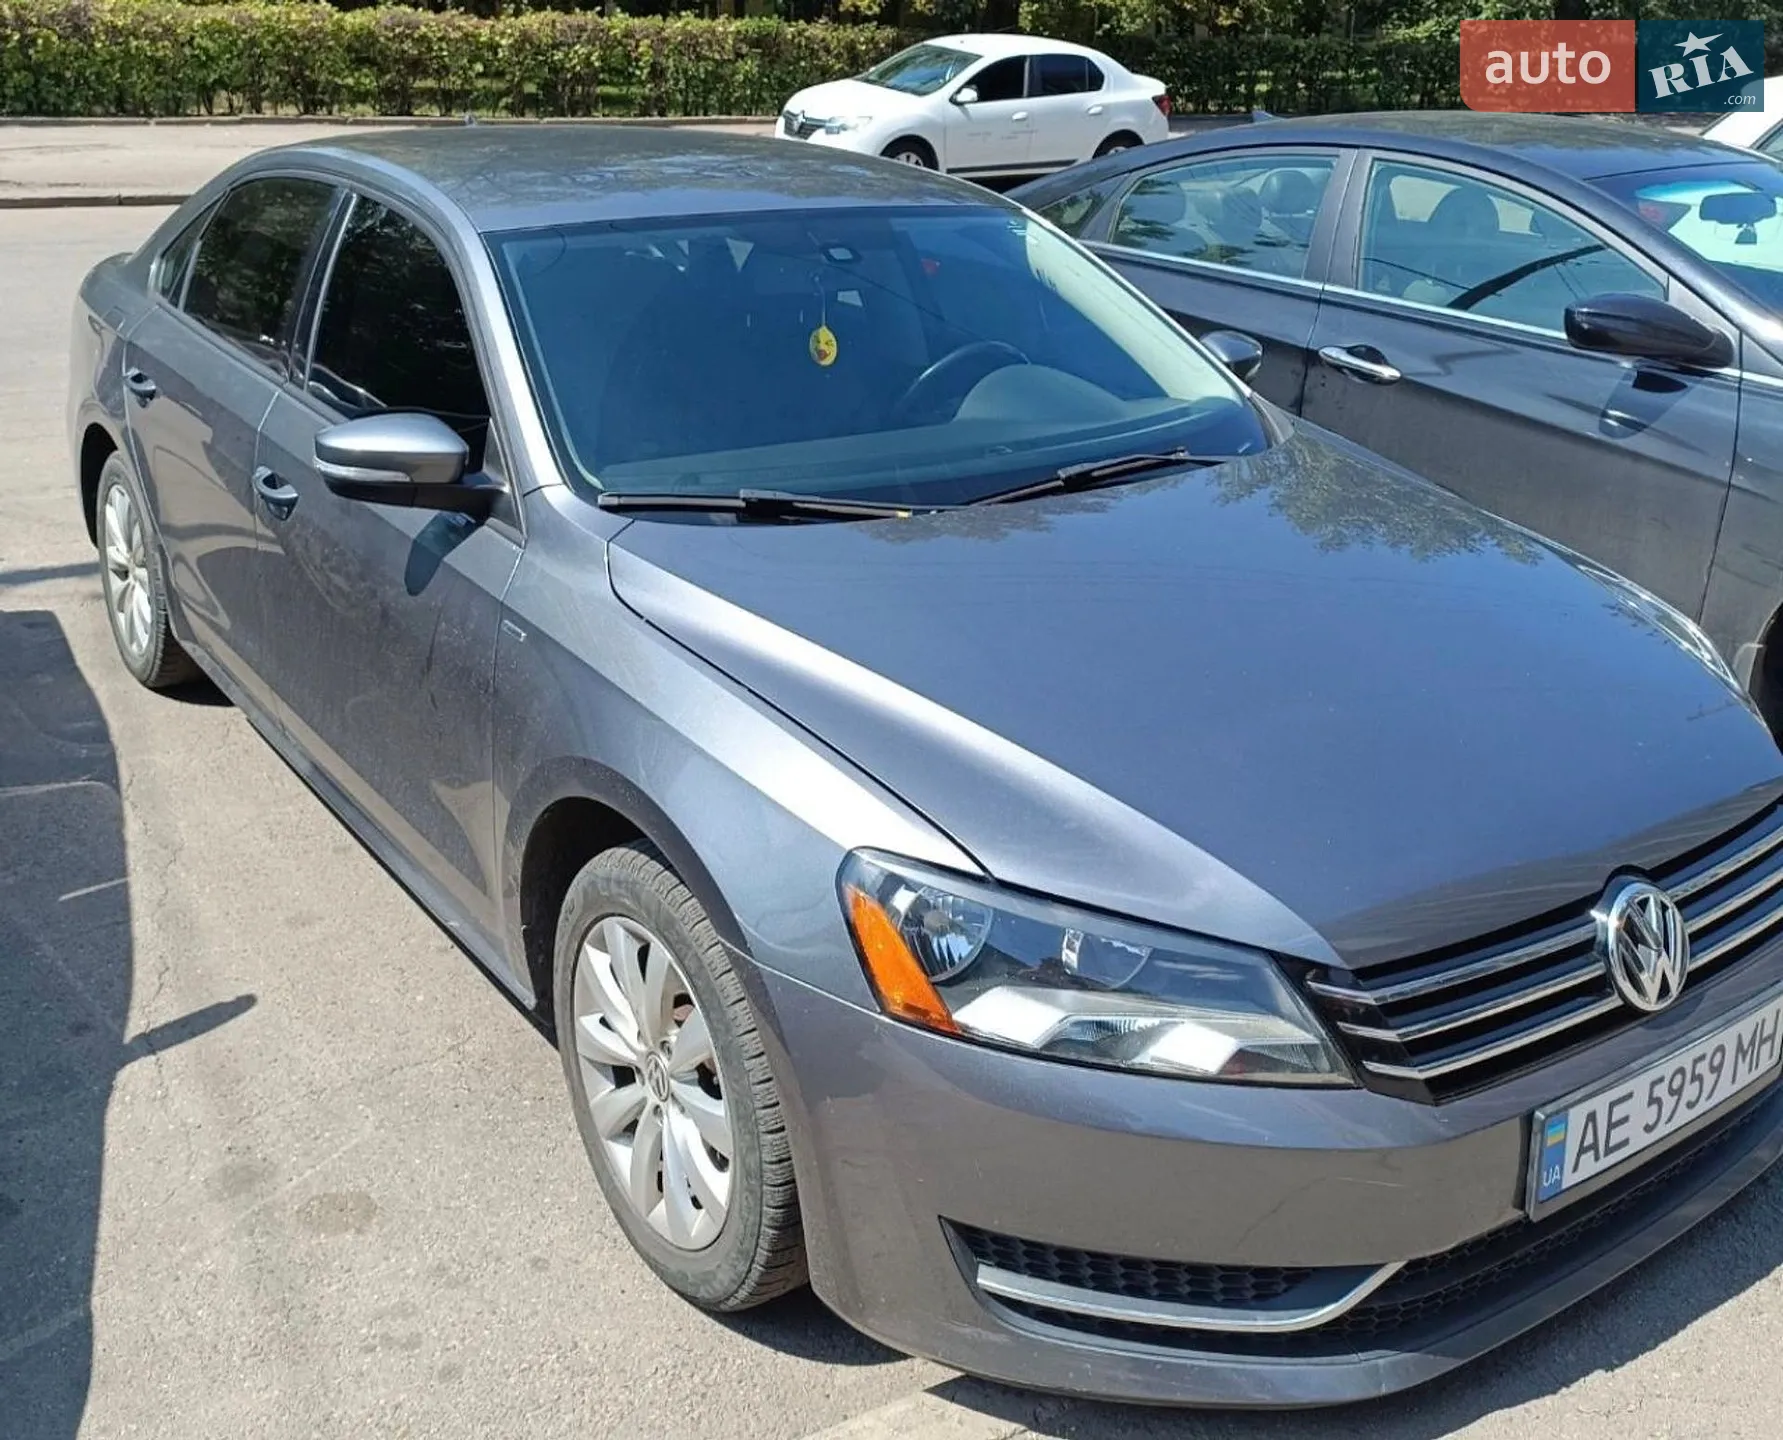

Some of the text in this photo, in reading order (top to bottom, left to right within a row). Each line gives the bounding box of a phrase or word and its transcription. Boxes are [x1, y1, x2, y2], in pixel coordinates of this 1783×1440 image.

[1572, 1008, 1781, 1174] AE 5959 MH
[1543, 1165, 1560, 1187] UA
